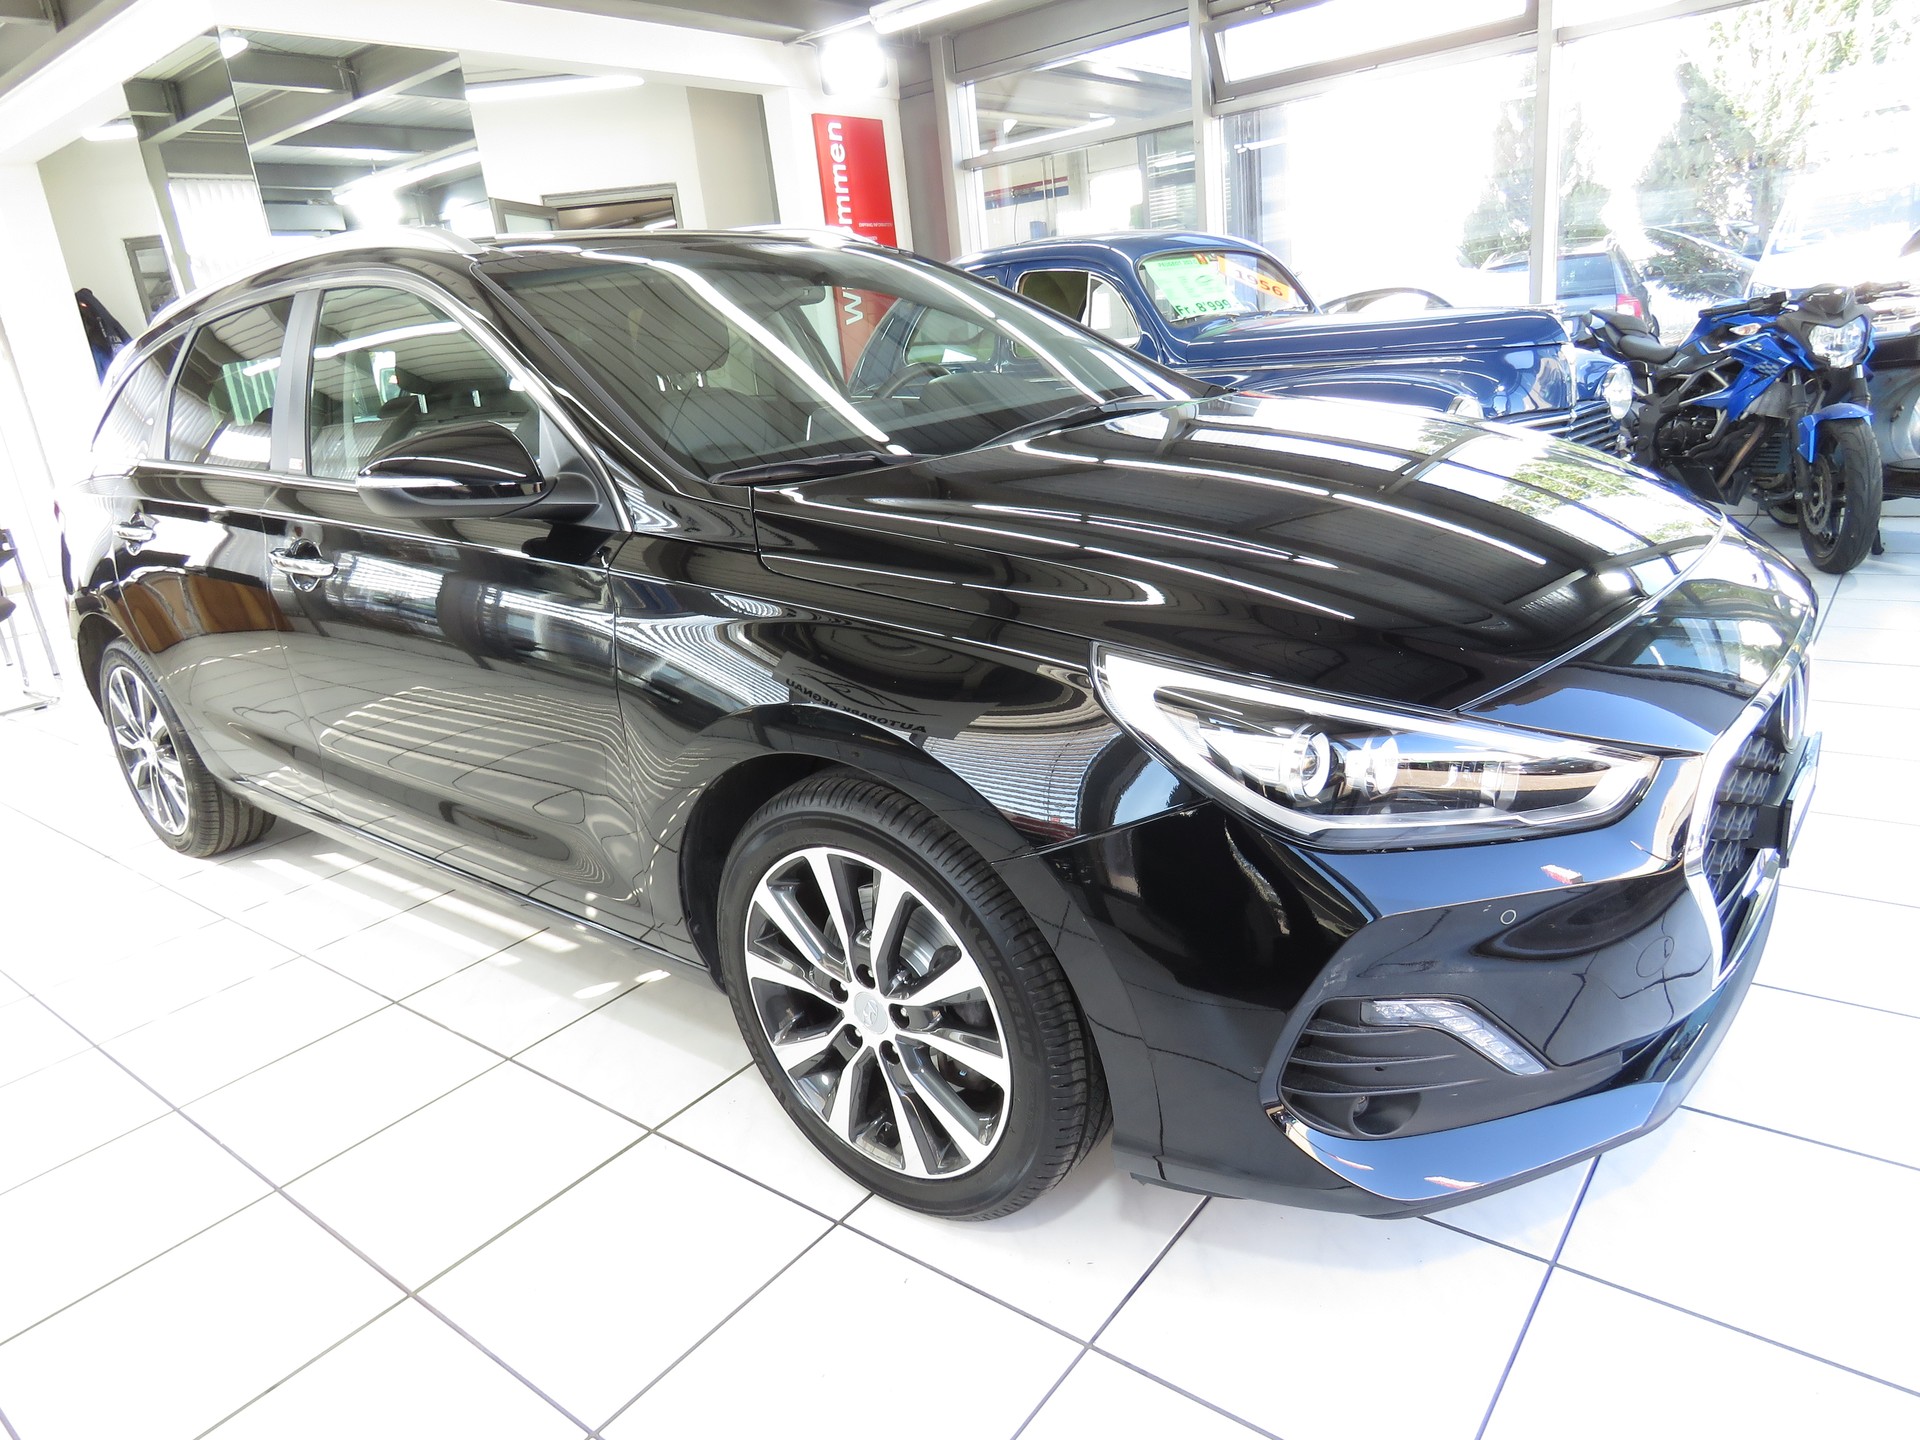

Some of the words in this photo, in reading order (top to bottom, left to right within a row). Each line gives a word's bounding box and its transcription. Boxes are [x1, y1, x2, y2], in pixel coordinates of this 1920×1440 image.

[1234, 269, 1283, 297] 1956
[1175, 304, 1196, 315] Fr.
[977, 938, 1034, 1058] MICHELIN
